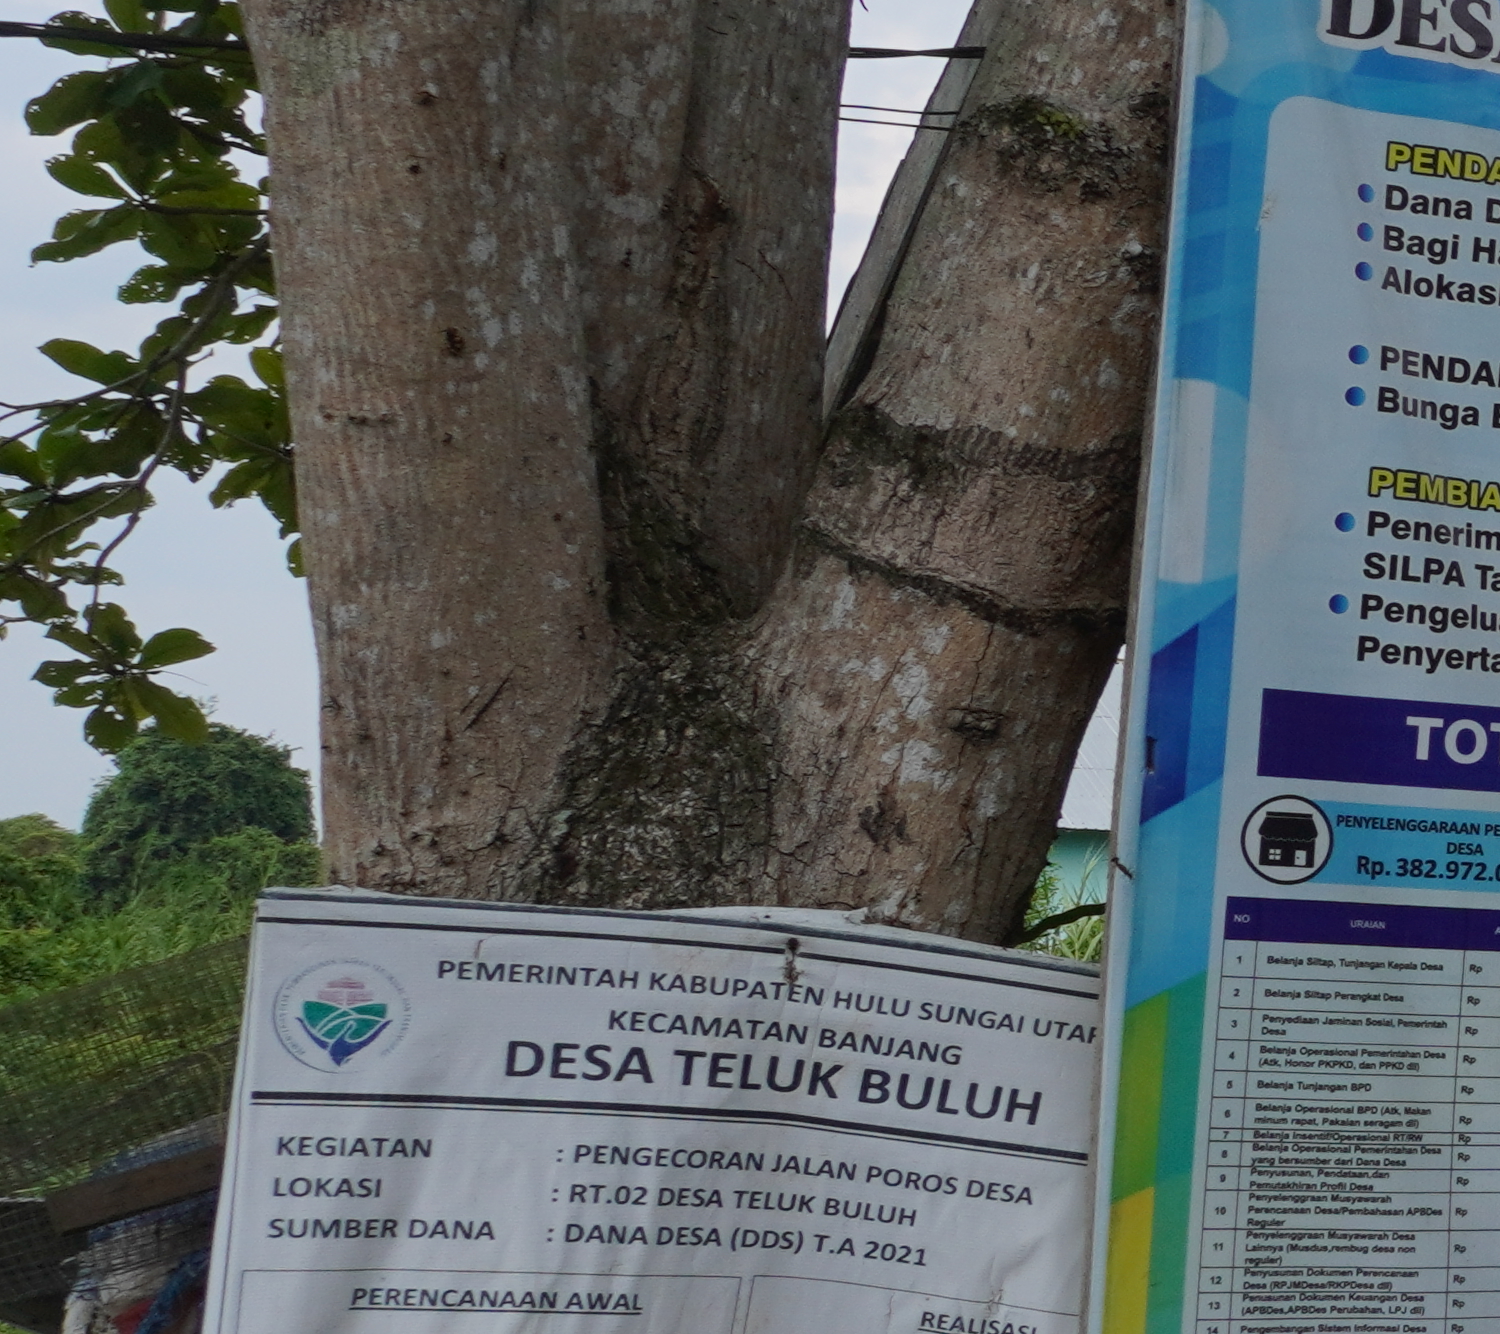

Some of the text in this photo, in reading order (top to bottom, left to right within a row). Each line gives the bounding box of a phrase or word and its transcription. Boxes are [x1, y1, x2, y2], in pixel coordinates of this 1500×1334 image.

[1385, 185, 1472, 220] Dana
[1384, 225, 1459, 265] Bagi
[1378, 387, 1479, 430] Bunga
[1363, 552, 1465, 587] SILPA
[1336, 815, 1480, 835] PENYELENGGARAAN
[1447, 842, 1484, 856] DESA
[1357, 856, 1390, 880] Rp.
[438, 960, 1024, 1033] PEMERINTAH KABUPATEN HULU SUNGAI
[609, 1011, 962, 1065] KECAMATAN BANJANG
[506, 1041, 1042, 1125] DESA TELUK BULUH
[278, 1137, 432, 1158] KEGIATAN
[575, 1145, 1032, 1205] PENGECORAN JALAN POROS DESA
[269, 1218, 494, 1240] SUMBER DANA
[565, 1224, 926, 1266] DANA DESA (DDS) 2021
[350, 1288, 643, 1311] PERENCANAAN AWAL
